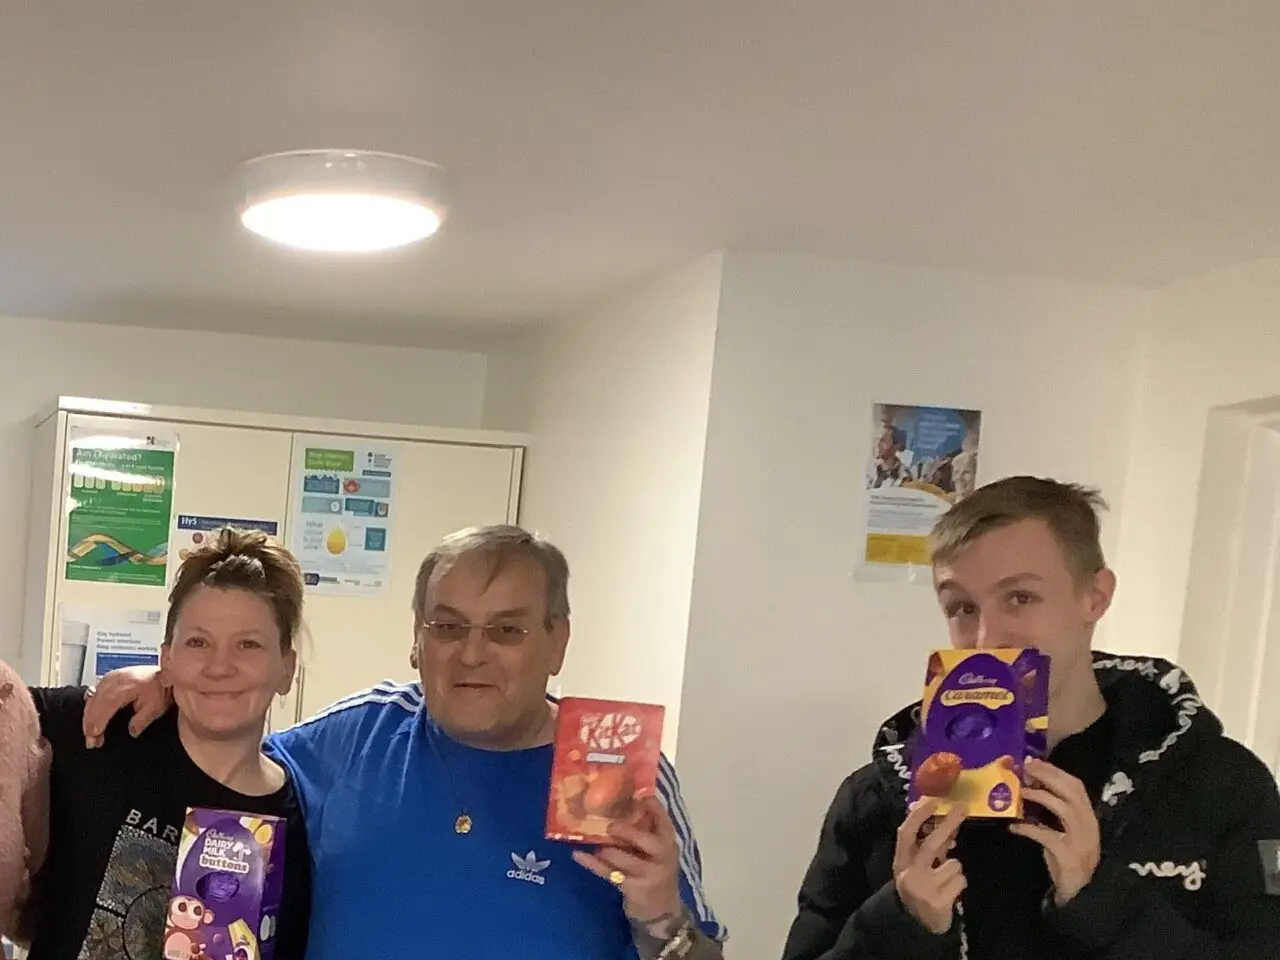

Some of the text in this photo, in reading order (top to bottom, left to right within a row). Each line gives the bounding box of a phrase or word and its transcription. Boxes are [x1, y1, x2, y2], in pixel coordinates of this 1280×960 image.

[944, 690, 1010, 701] Caramel
[204, 838, 235, 849] DAIRY
[201, 855, 248, 871] buttons
[506, 869, 546, 885] adidas
